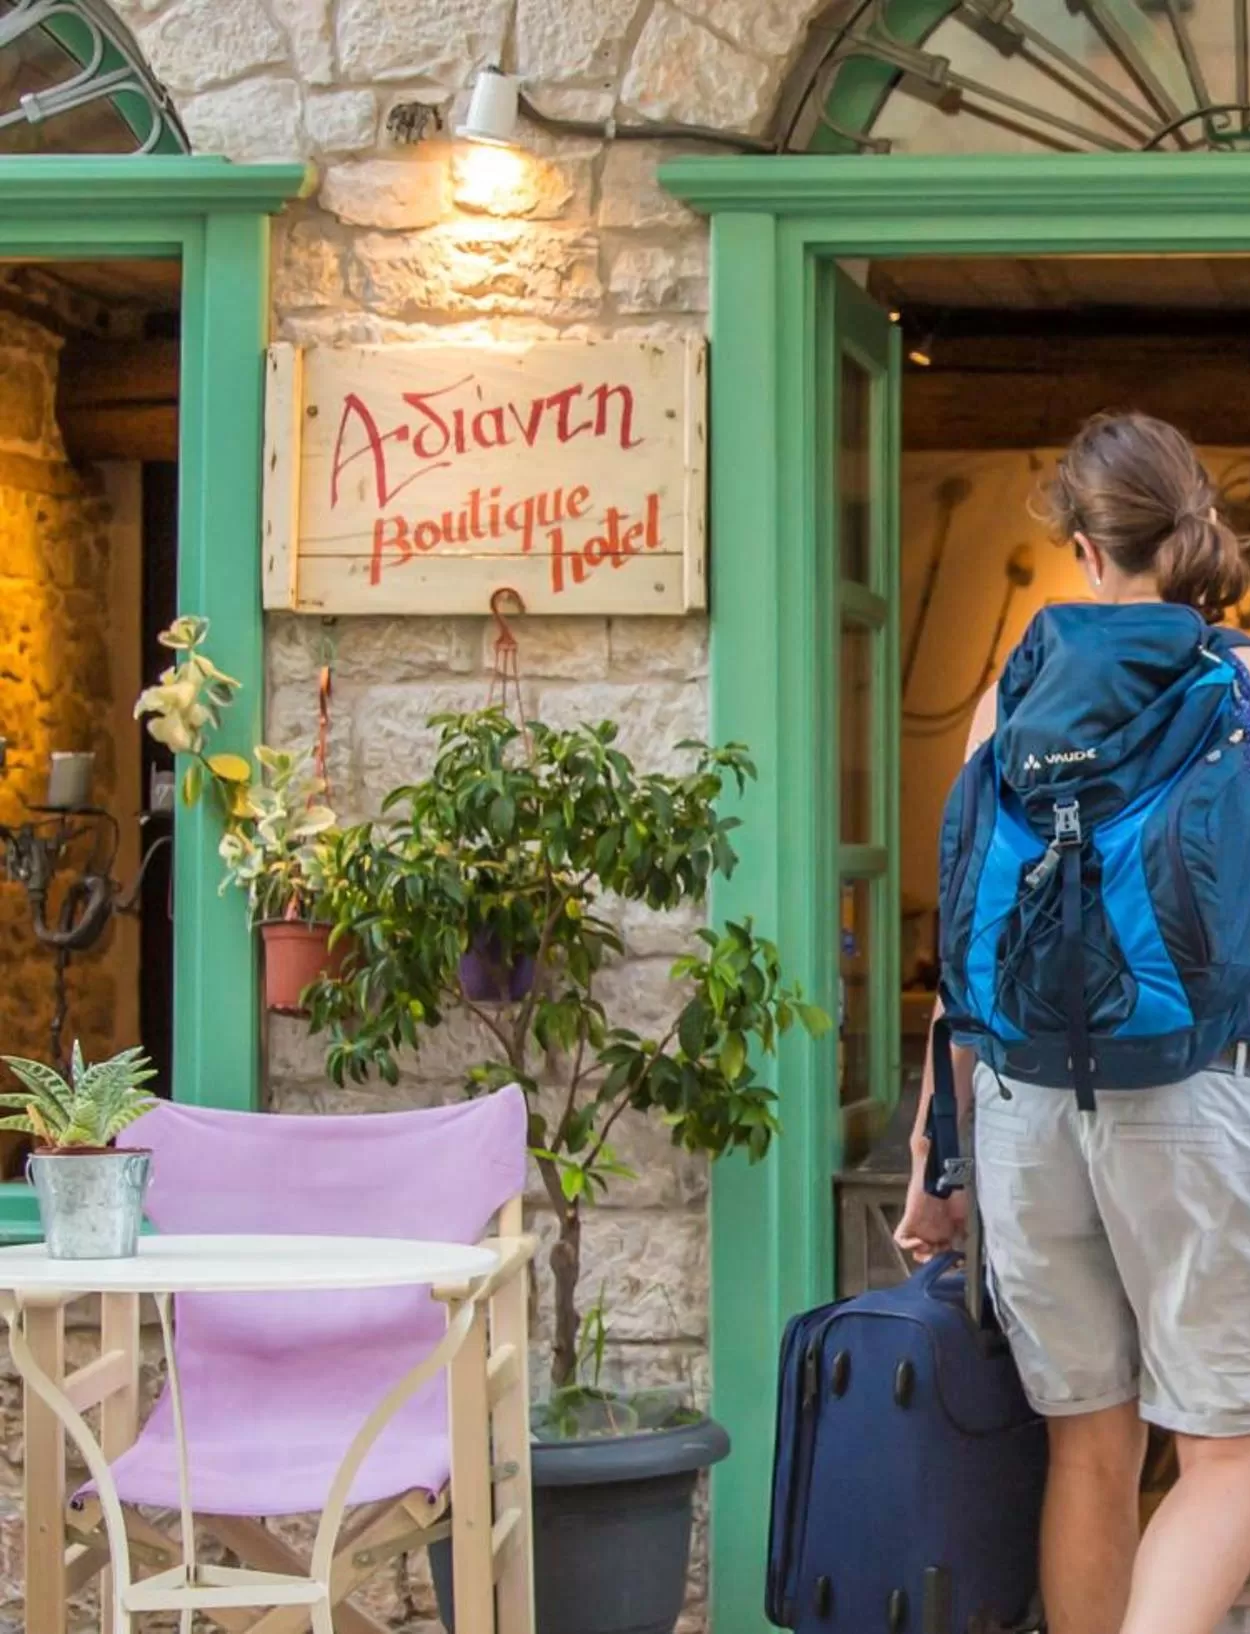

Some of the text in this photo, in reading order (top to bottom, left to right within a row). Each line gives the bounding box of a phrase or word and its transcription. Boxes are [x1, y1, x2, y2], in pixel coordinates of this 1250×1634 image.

[369, 483, 595, 586] Boutique
[546, 493, 665, 594] hotel
[1043, 747, 1097, 765] VAUDE
